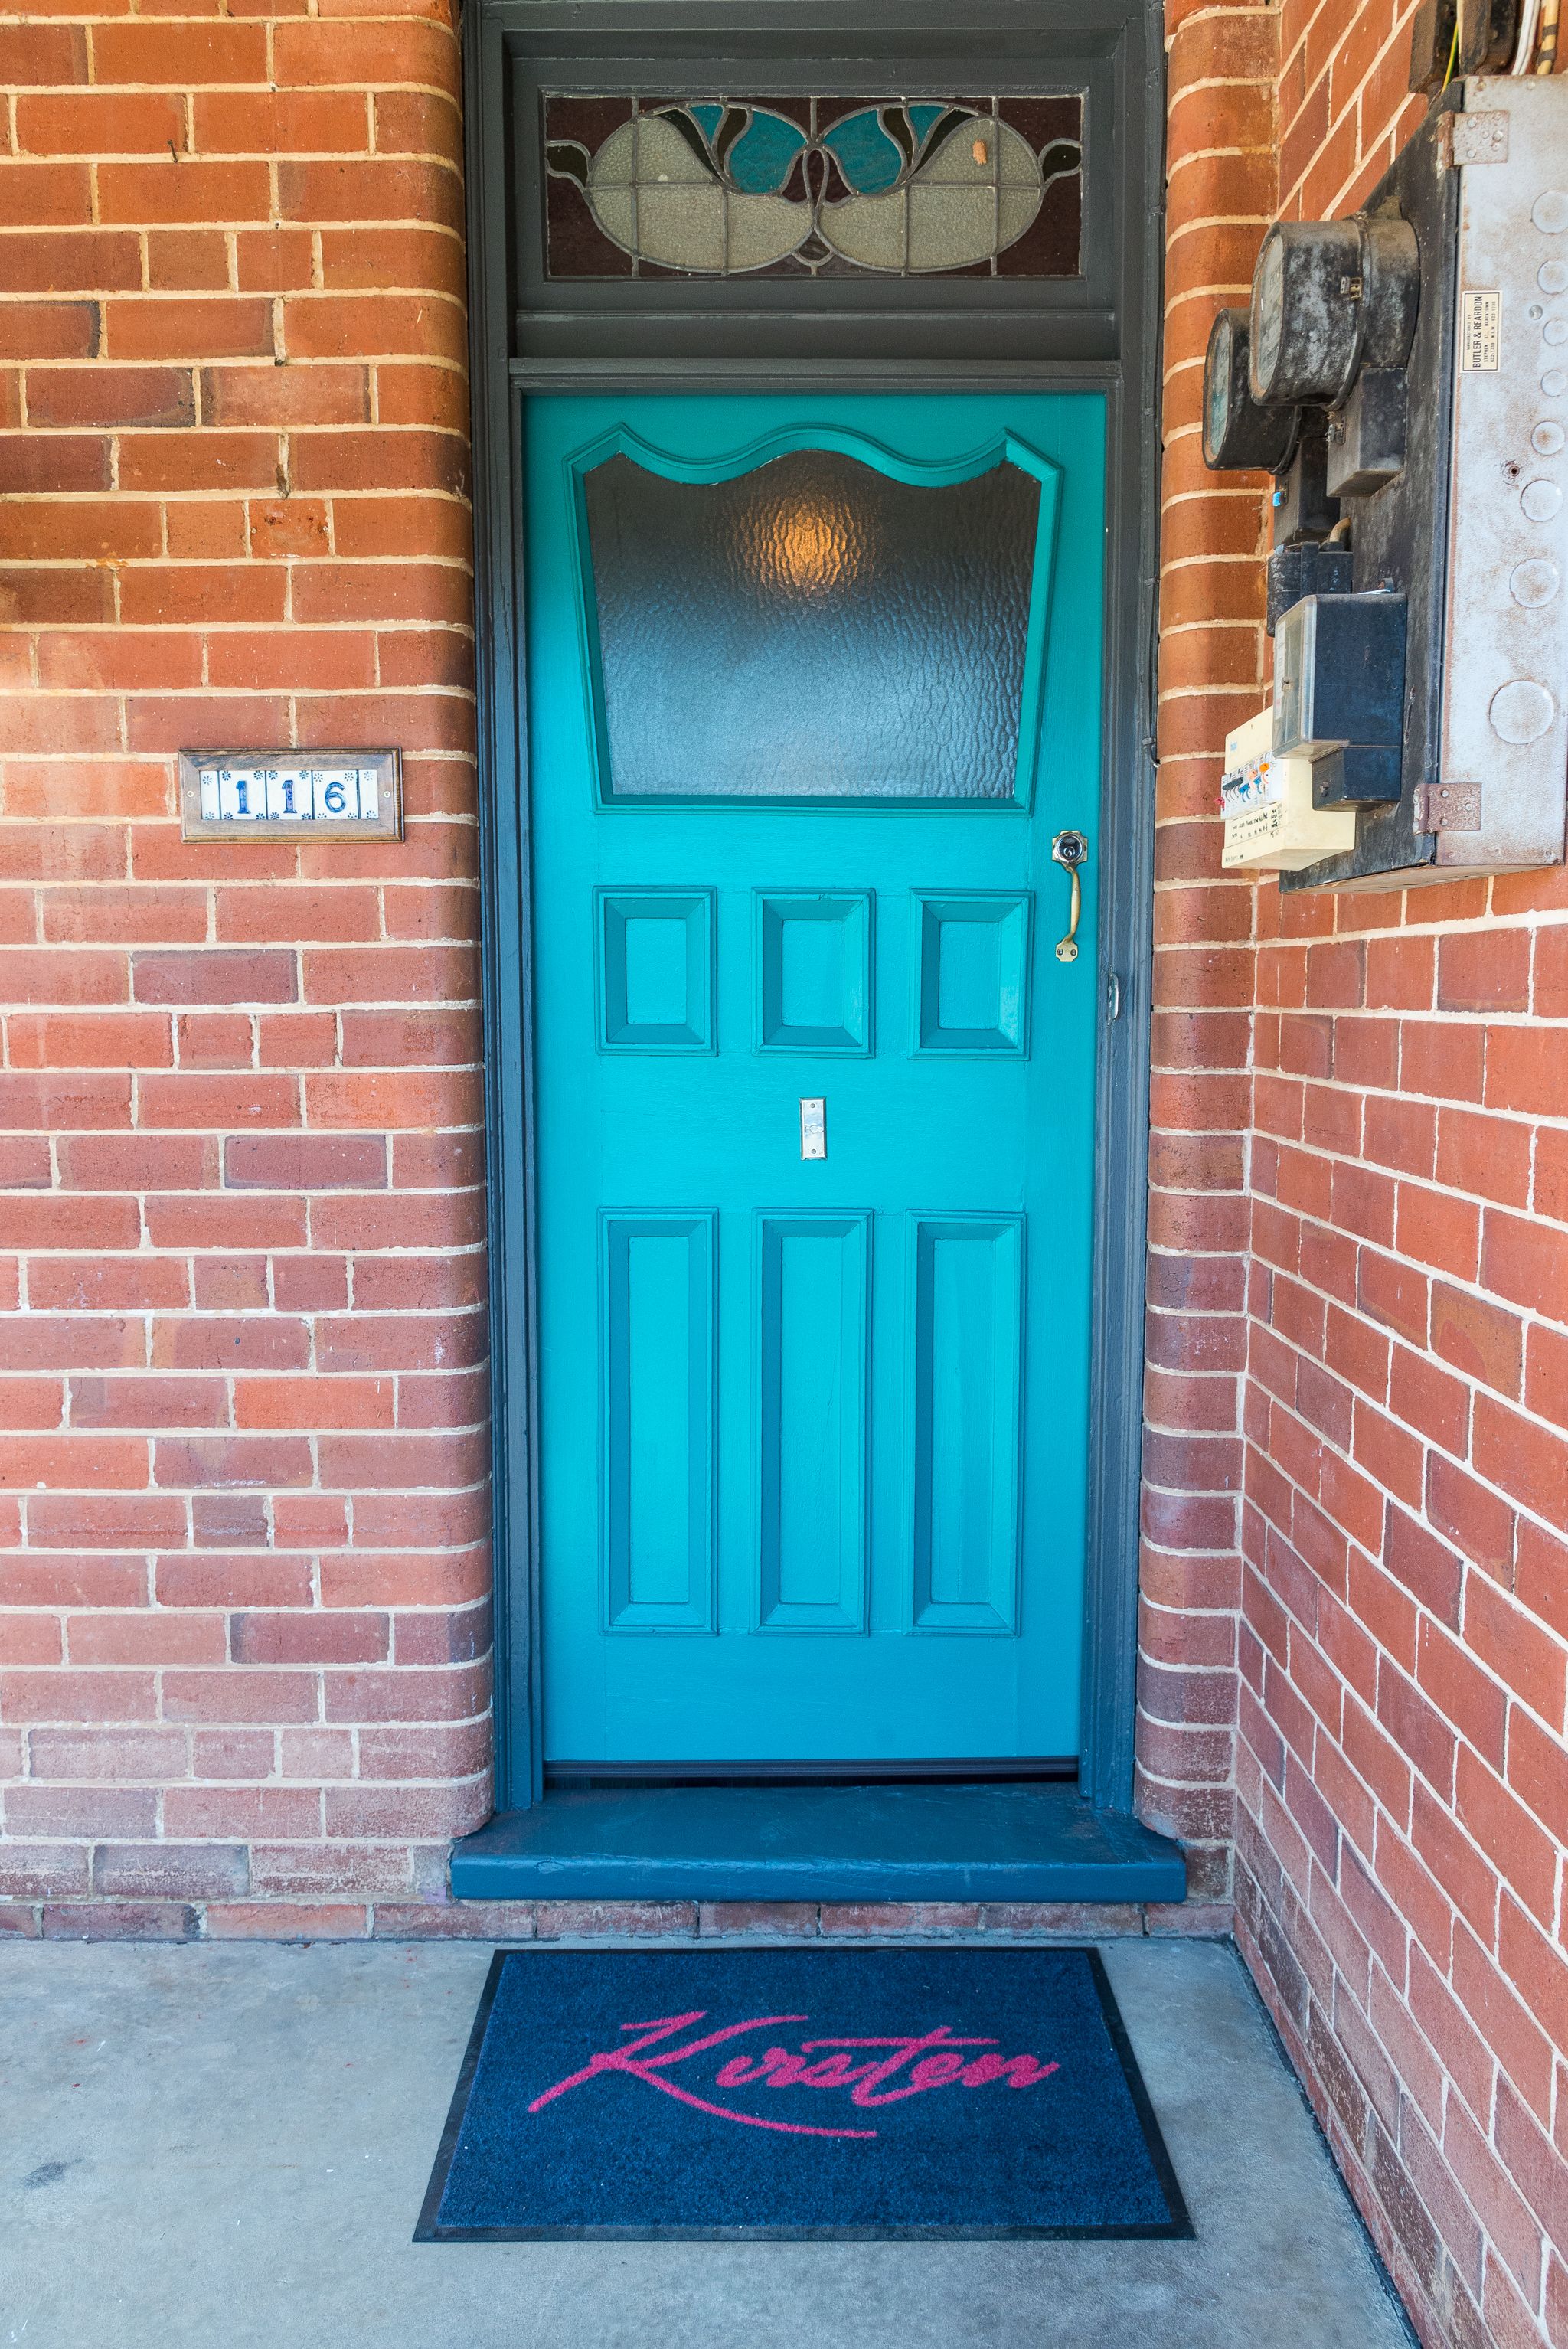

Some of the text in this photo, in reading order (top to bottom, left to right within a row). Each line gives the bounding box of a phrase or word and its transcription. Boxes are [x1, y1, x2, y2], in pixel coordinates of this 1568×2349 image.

[1473, 296, 1483, 330] REARDON
[1472, 340, 1481, 368] BUTLER
[235, 779, 346, 814] 116
